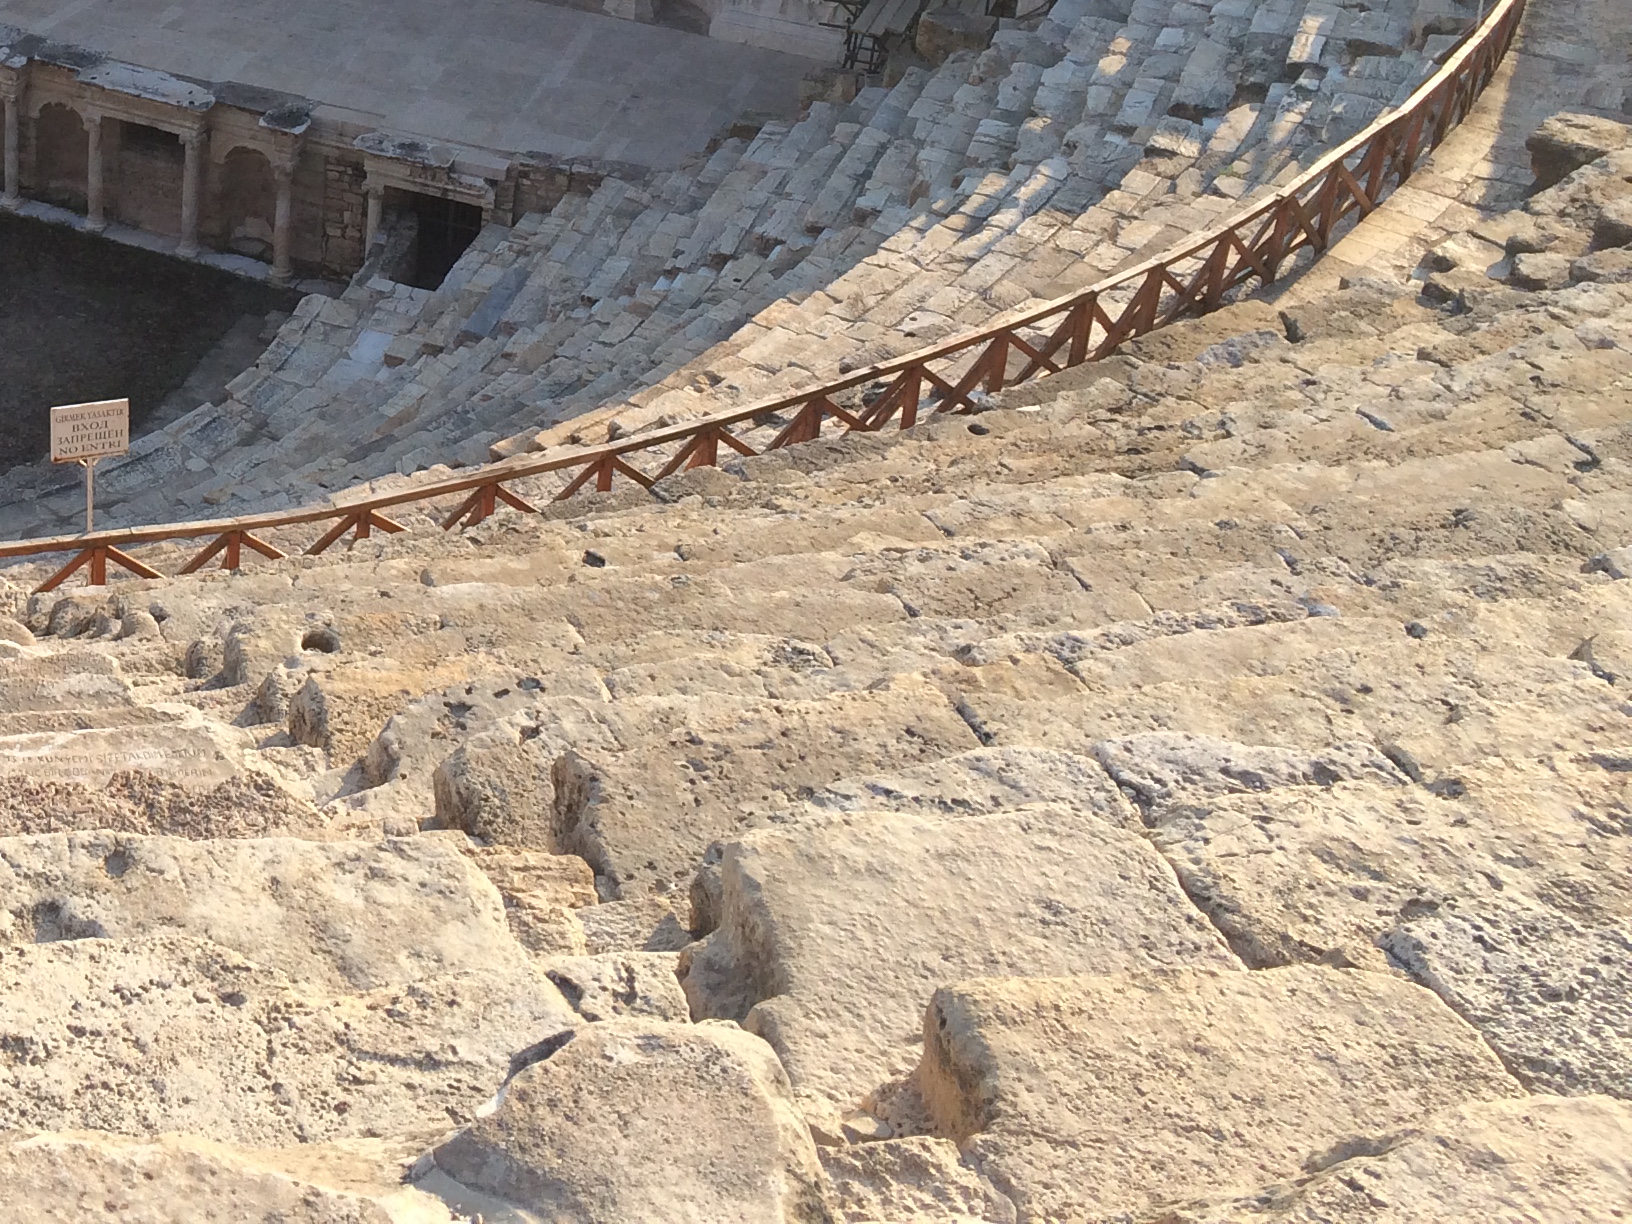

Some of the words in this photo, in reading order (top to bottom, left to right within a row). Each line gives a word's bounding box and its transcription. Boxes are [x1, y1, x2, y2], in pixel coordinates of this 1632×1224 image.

[72, 420, 108, 432] ВХОД
[59, 445, 78, 455] NO
[81, 440, 121, 452] ENTRI
